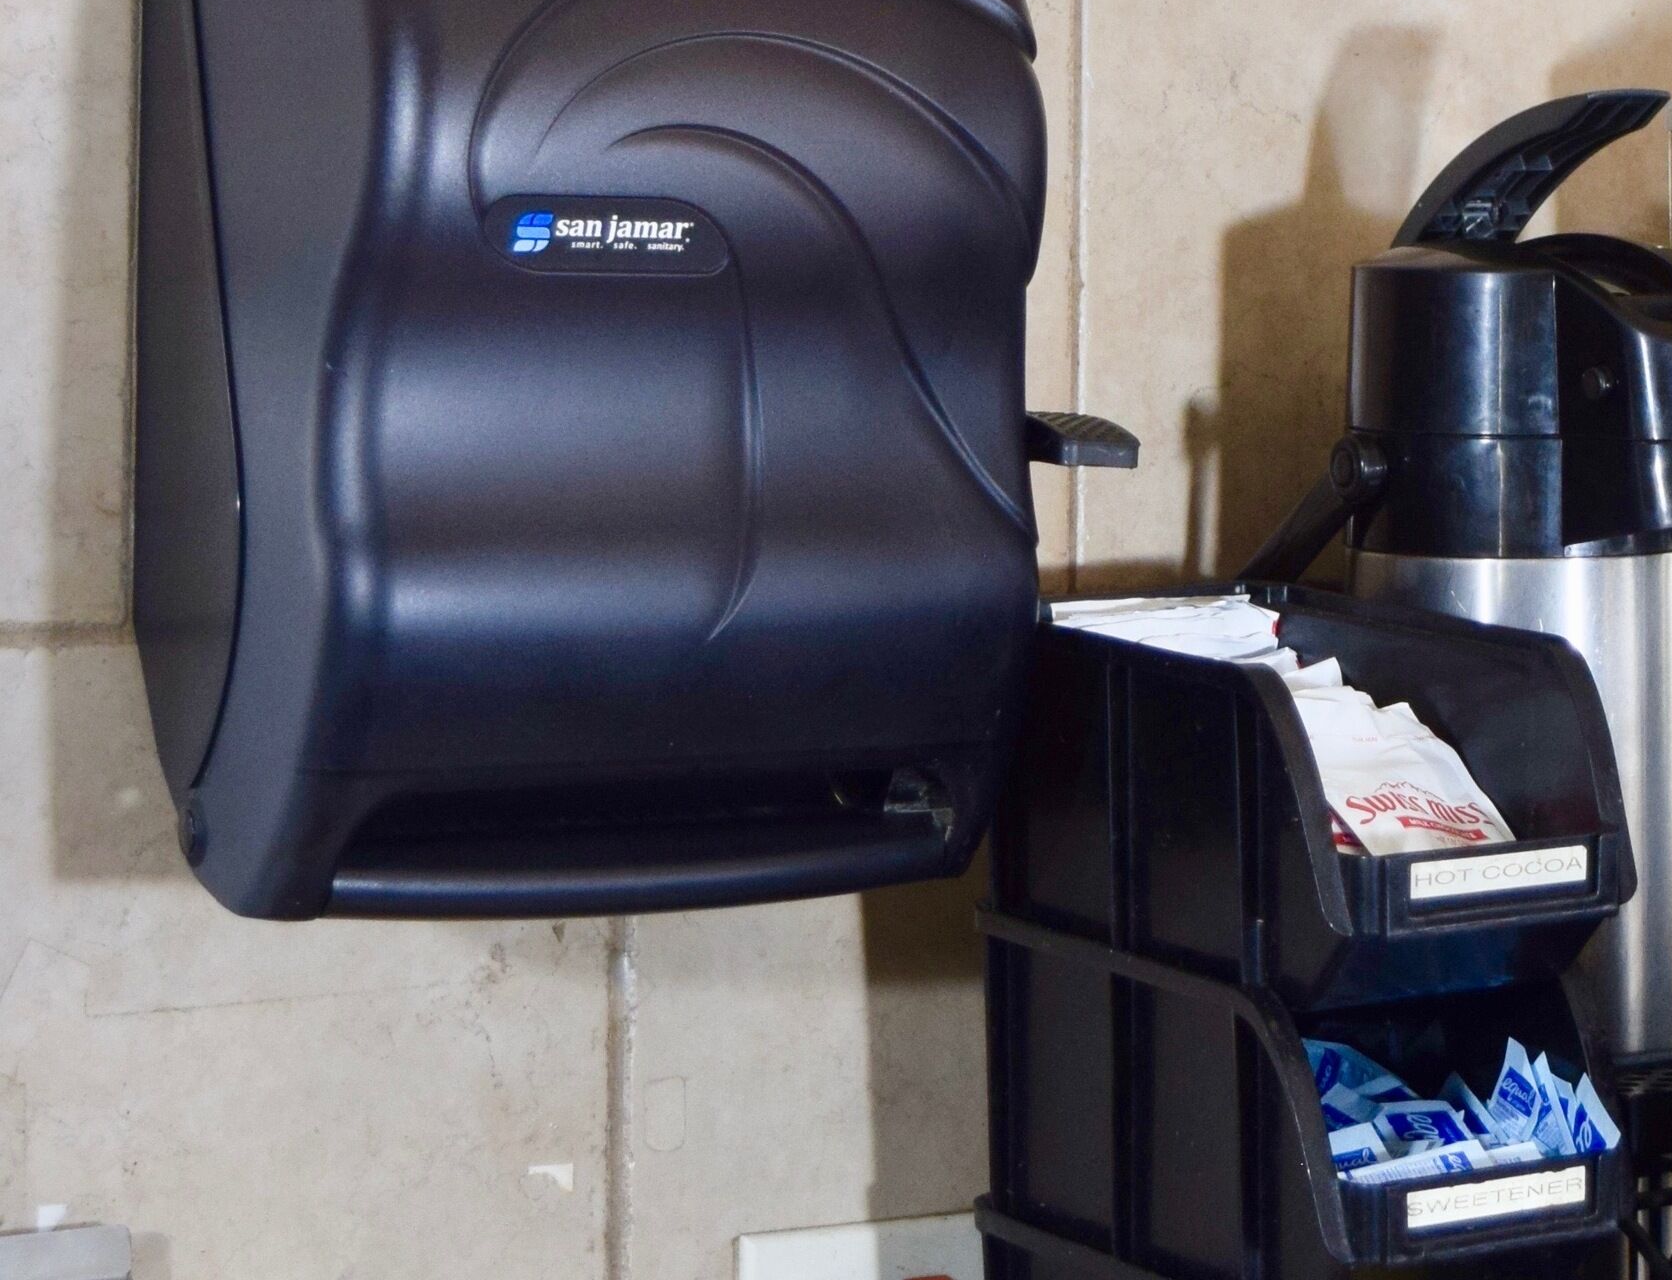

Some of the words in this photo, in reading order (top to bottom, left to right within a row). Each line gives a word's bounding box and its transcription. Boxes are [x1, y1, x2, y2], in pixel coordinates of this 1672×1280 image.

[556, 218, 602, 237] san
[606, 214, 689, 243] jamar
[571, 241, 603, 249] smart.
[613, 240, 637, 250] safe.
[1414, 868, 1473, 888] HOT
[1482, 855, 1583, 881] COCOA
[1502, 1077, 1537, 1110] equal
[1407, 1176, 1586, 1217] SWEETENER
